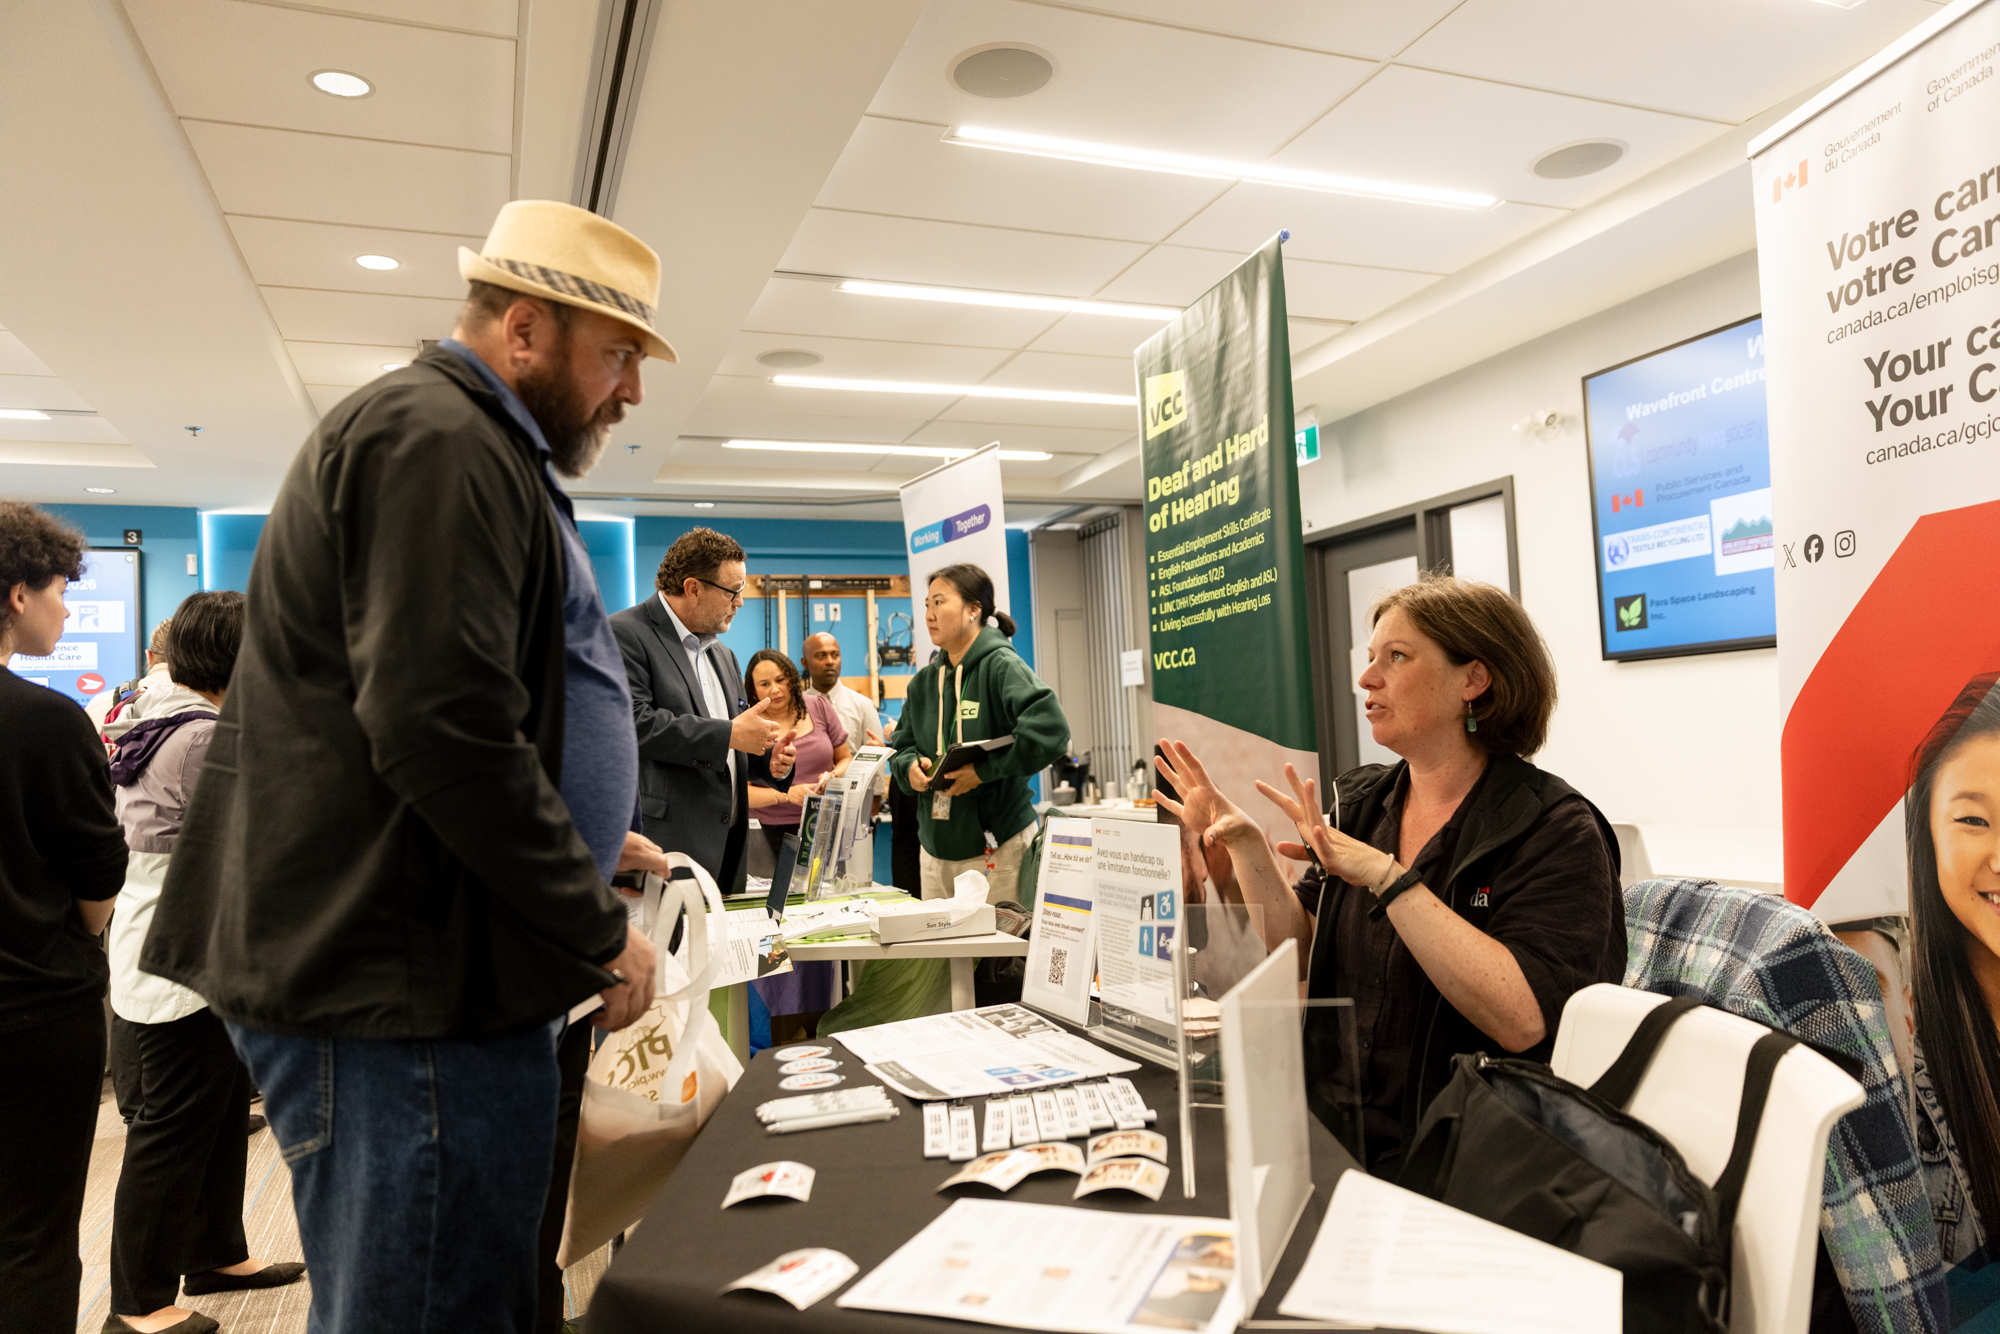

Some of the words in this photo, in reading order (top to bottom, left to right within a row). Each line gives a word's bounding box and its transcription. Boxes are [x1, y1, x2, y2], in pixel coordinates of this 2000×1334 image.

[1927, 96, 1940, 112] of
[1943, 65, 1994, 103] Canada
[1825, 101, 1902, 157] Gouvernement
[1825, 158, 1838, 173] du
[1841, 132, 1881, 163] Canada
[1827, 209, 1919, 271] Votre
[1827, 256, 1916, 314] votre
[1827, 263, 2000, 344] canada.ca/emploisg
[1863, 337, 1952, 389] Your
[1626, 383, 1707, 420] Wavefront
[1711, 366, 1766, 395] Centre
[1865, 383, 1953, 433] Your
[1149, 460, 1190, 502] Deaf
[1192, 442, 1224, 482] and
[1225, 413, 1268, 465] Hard
[1655, 480, 1682, 492] Public
[1684, 470, 1723, 486] Services
[1725, 463, 1743, 476] and
[1149, 503, 1169, 533] of
[1171, 474, 1240, 525] Hearing
[1656, 484, 1712, 503] Procurement
[1714, 474, 1751, 490] Canada
[127, 532, 138, 543] 3
[914, 530, 939, 548] Working
[956, 513, 985, 533] Together
[1158, 542, 1185, 562] Essential
[1185, 528, 1223, 553] Employment
[1222, 521, 1240, 539] Skills
[1240, 508, 1271, 531] Certificate
[1158, 562, 1181, 579] English
[1181, 550, 1218, 573] Foundations
[1218, 543, 1231, 560] and
[1231, 532, 1265, 555] Academics
[1159, 583, 1173, 597] ASL
[1172, 574, 1208, 593] Foundations
[1208, 565, 1225, 583] 1/2/3
[1159, 600, 1176, 615] LINC
[1176, 596, 1189, 611] DHH
[1189, 585, 1226, 608] (Settlement
[1226, 577, 1250, 596] English
[1250, 572, 1262, 589] and
[1650, 598, 1668, 607] Para
[1670, 594, 1696, 606] Space
[1697, 586, 1756, 601] Landscaping
[1160, 618, 1181, 632] Living
[1181, 607, 1216, 627] Successfully
[1216, 603, 1232, 618] with
[1232, 597, 1257, 614] Hearing
[1257, 593, 1271, 608] Loss
[20, 653, 55, 661] Health
[1097, 847, 1121, 860] Avez-vous
[1123, 852, 1129, 861] un
[1130, 851, 1155, 867] handicap
[1156, 857, 1164, 866] ou
[1097, 861, 1106, 870] une
[1107, 860, 1131, 874] limitation
[1132, 864, 1171, 881] fonctionnelle?
[938, 921, 951, 929] Style
